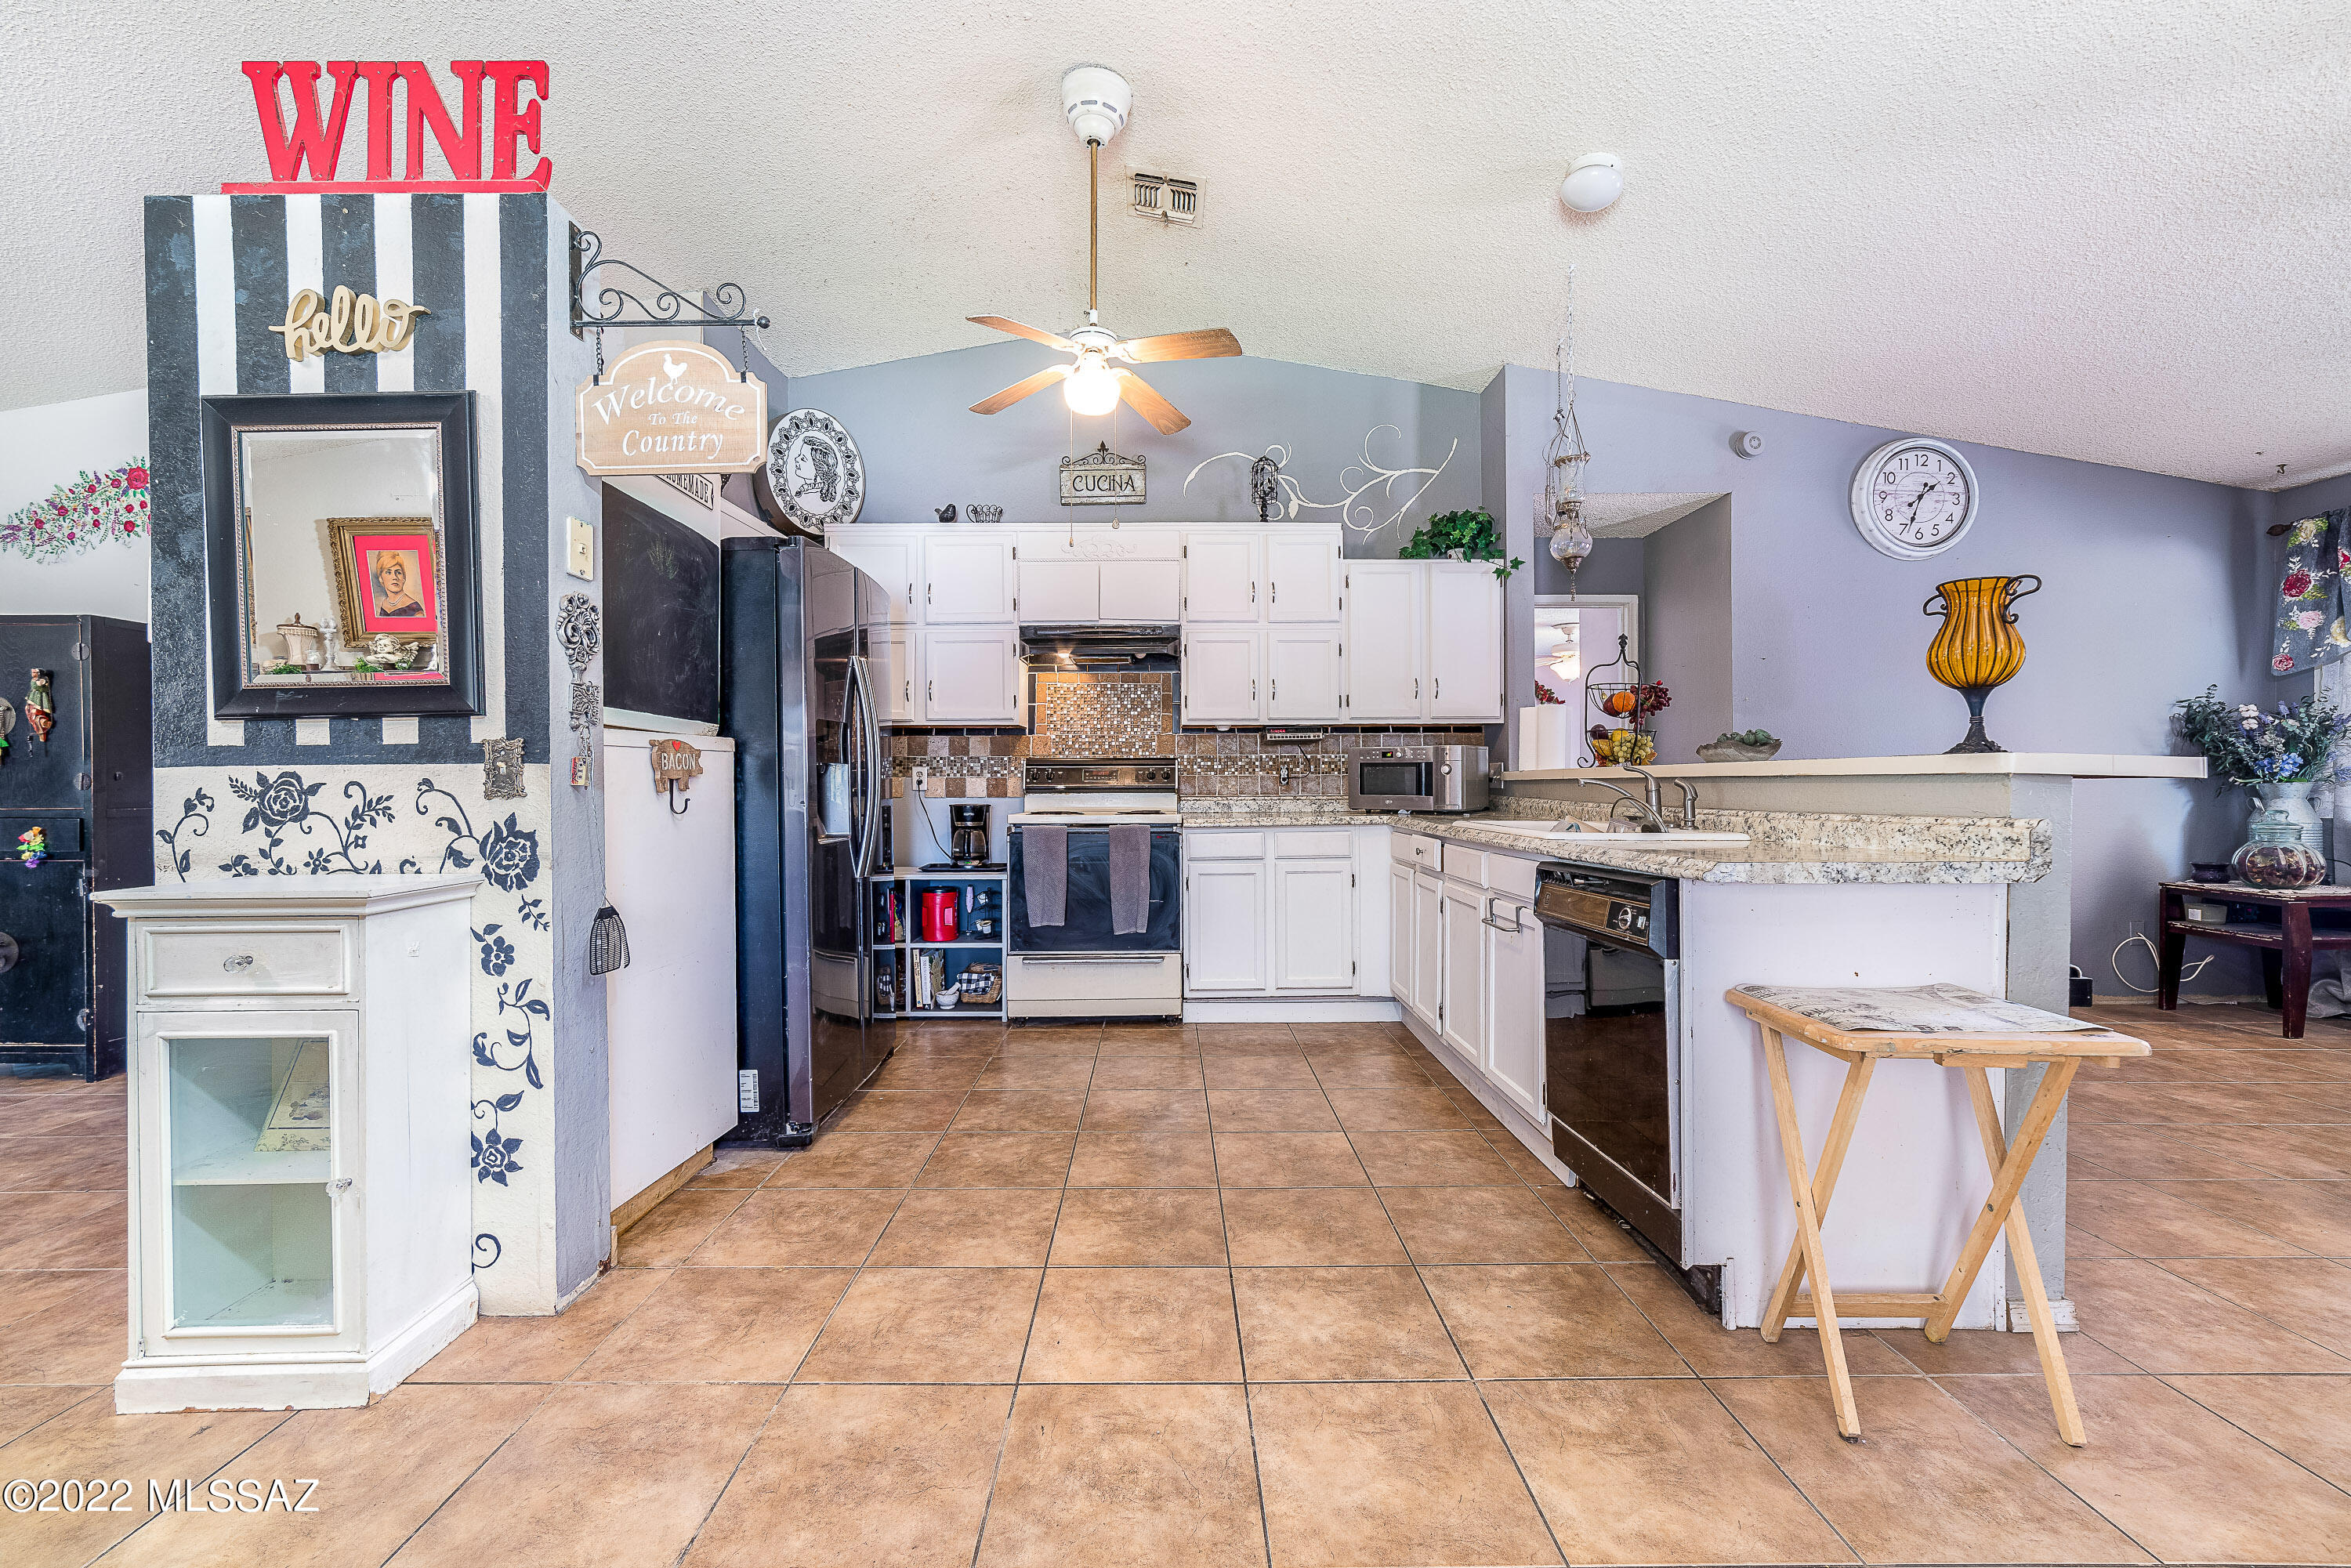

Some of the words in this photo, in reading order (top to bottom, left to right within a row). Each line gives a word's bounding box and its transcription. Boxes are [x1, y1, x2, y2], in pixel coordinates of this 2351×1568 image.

[241, 60, 552, 188] WINE
[268, 284, 432, 362] hello
[592, 376, 745, 425] Welcome
[648, 412, 666, 425] To
[672, 411, 697, 425] The
[622, 429, 723, 460] Country
[1898, 458, 1909, 470] 11
[1914, 454, 1929, 466] 12
[1072, 475, 1136, 492] CUCINA
[1882, 472, 1896, 484] 10
[1947, 472, 1955, 484] 2
[666, 473, 708, 503] MEMADE
[1878, 491, 1888, 503] 9
[1952, 493, 1960, 505] 3
[1885, 509, 1893, 521] 8
[1945, 512, 1954, 523] 4
[1900, 523, 1908, 535] 7
[1914, 527, 1923, 540] 6
[1931, 524, 1940, 536] 5
[661, 752, 696, 770] BACON
